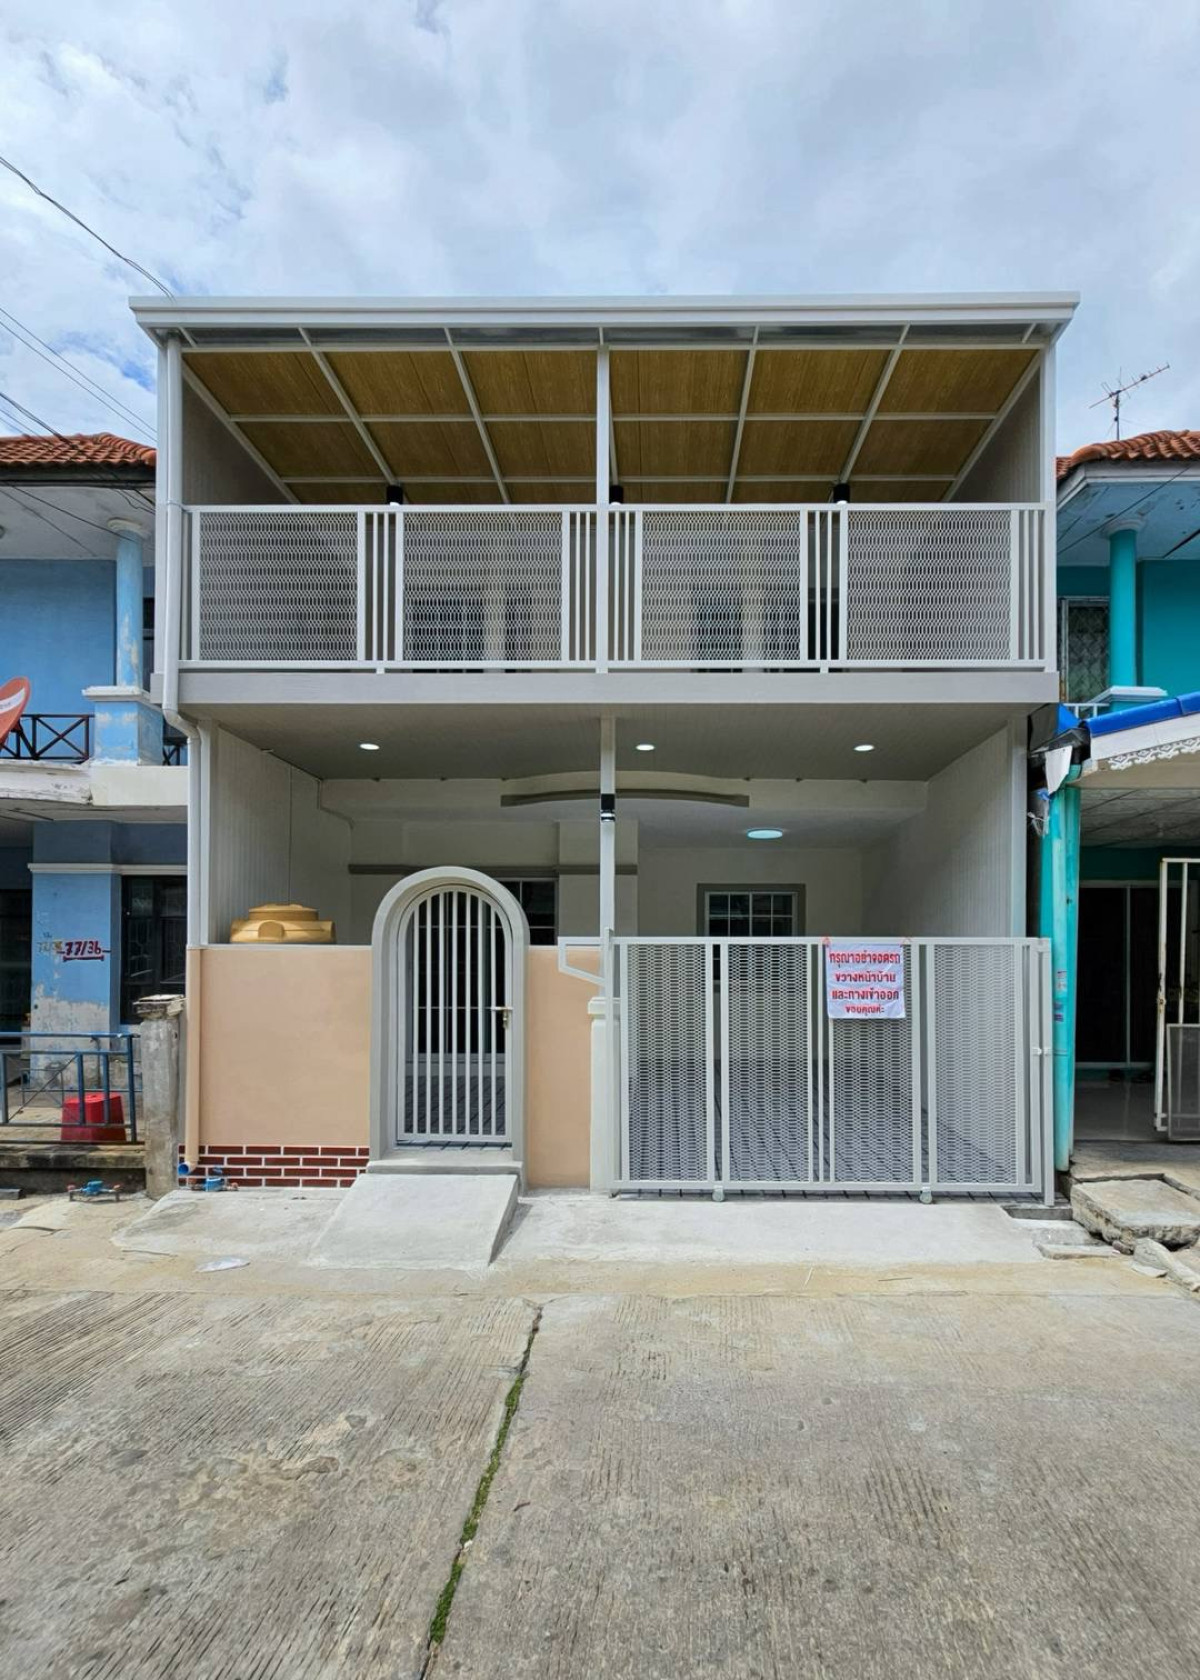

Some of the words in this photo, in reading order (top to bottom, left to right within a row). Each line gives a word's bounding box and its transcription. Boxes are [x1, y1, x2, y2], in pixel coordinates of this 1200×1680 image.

[829, 950, 901, 968] กรุณาอย่าจอดรถ
[835, 970, 897, 982] ขวางหน้าบ้าน
[831, 987, 900, 1000] และทางเข้าออก
